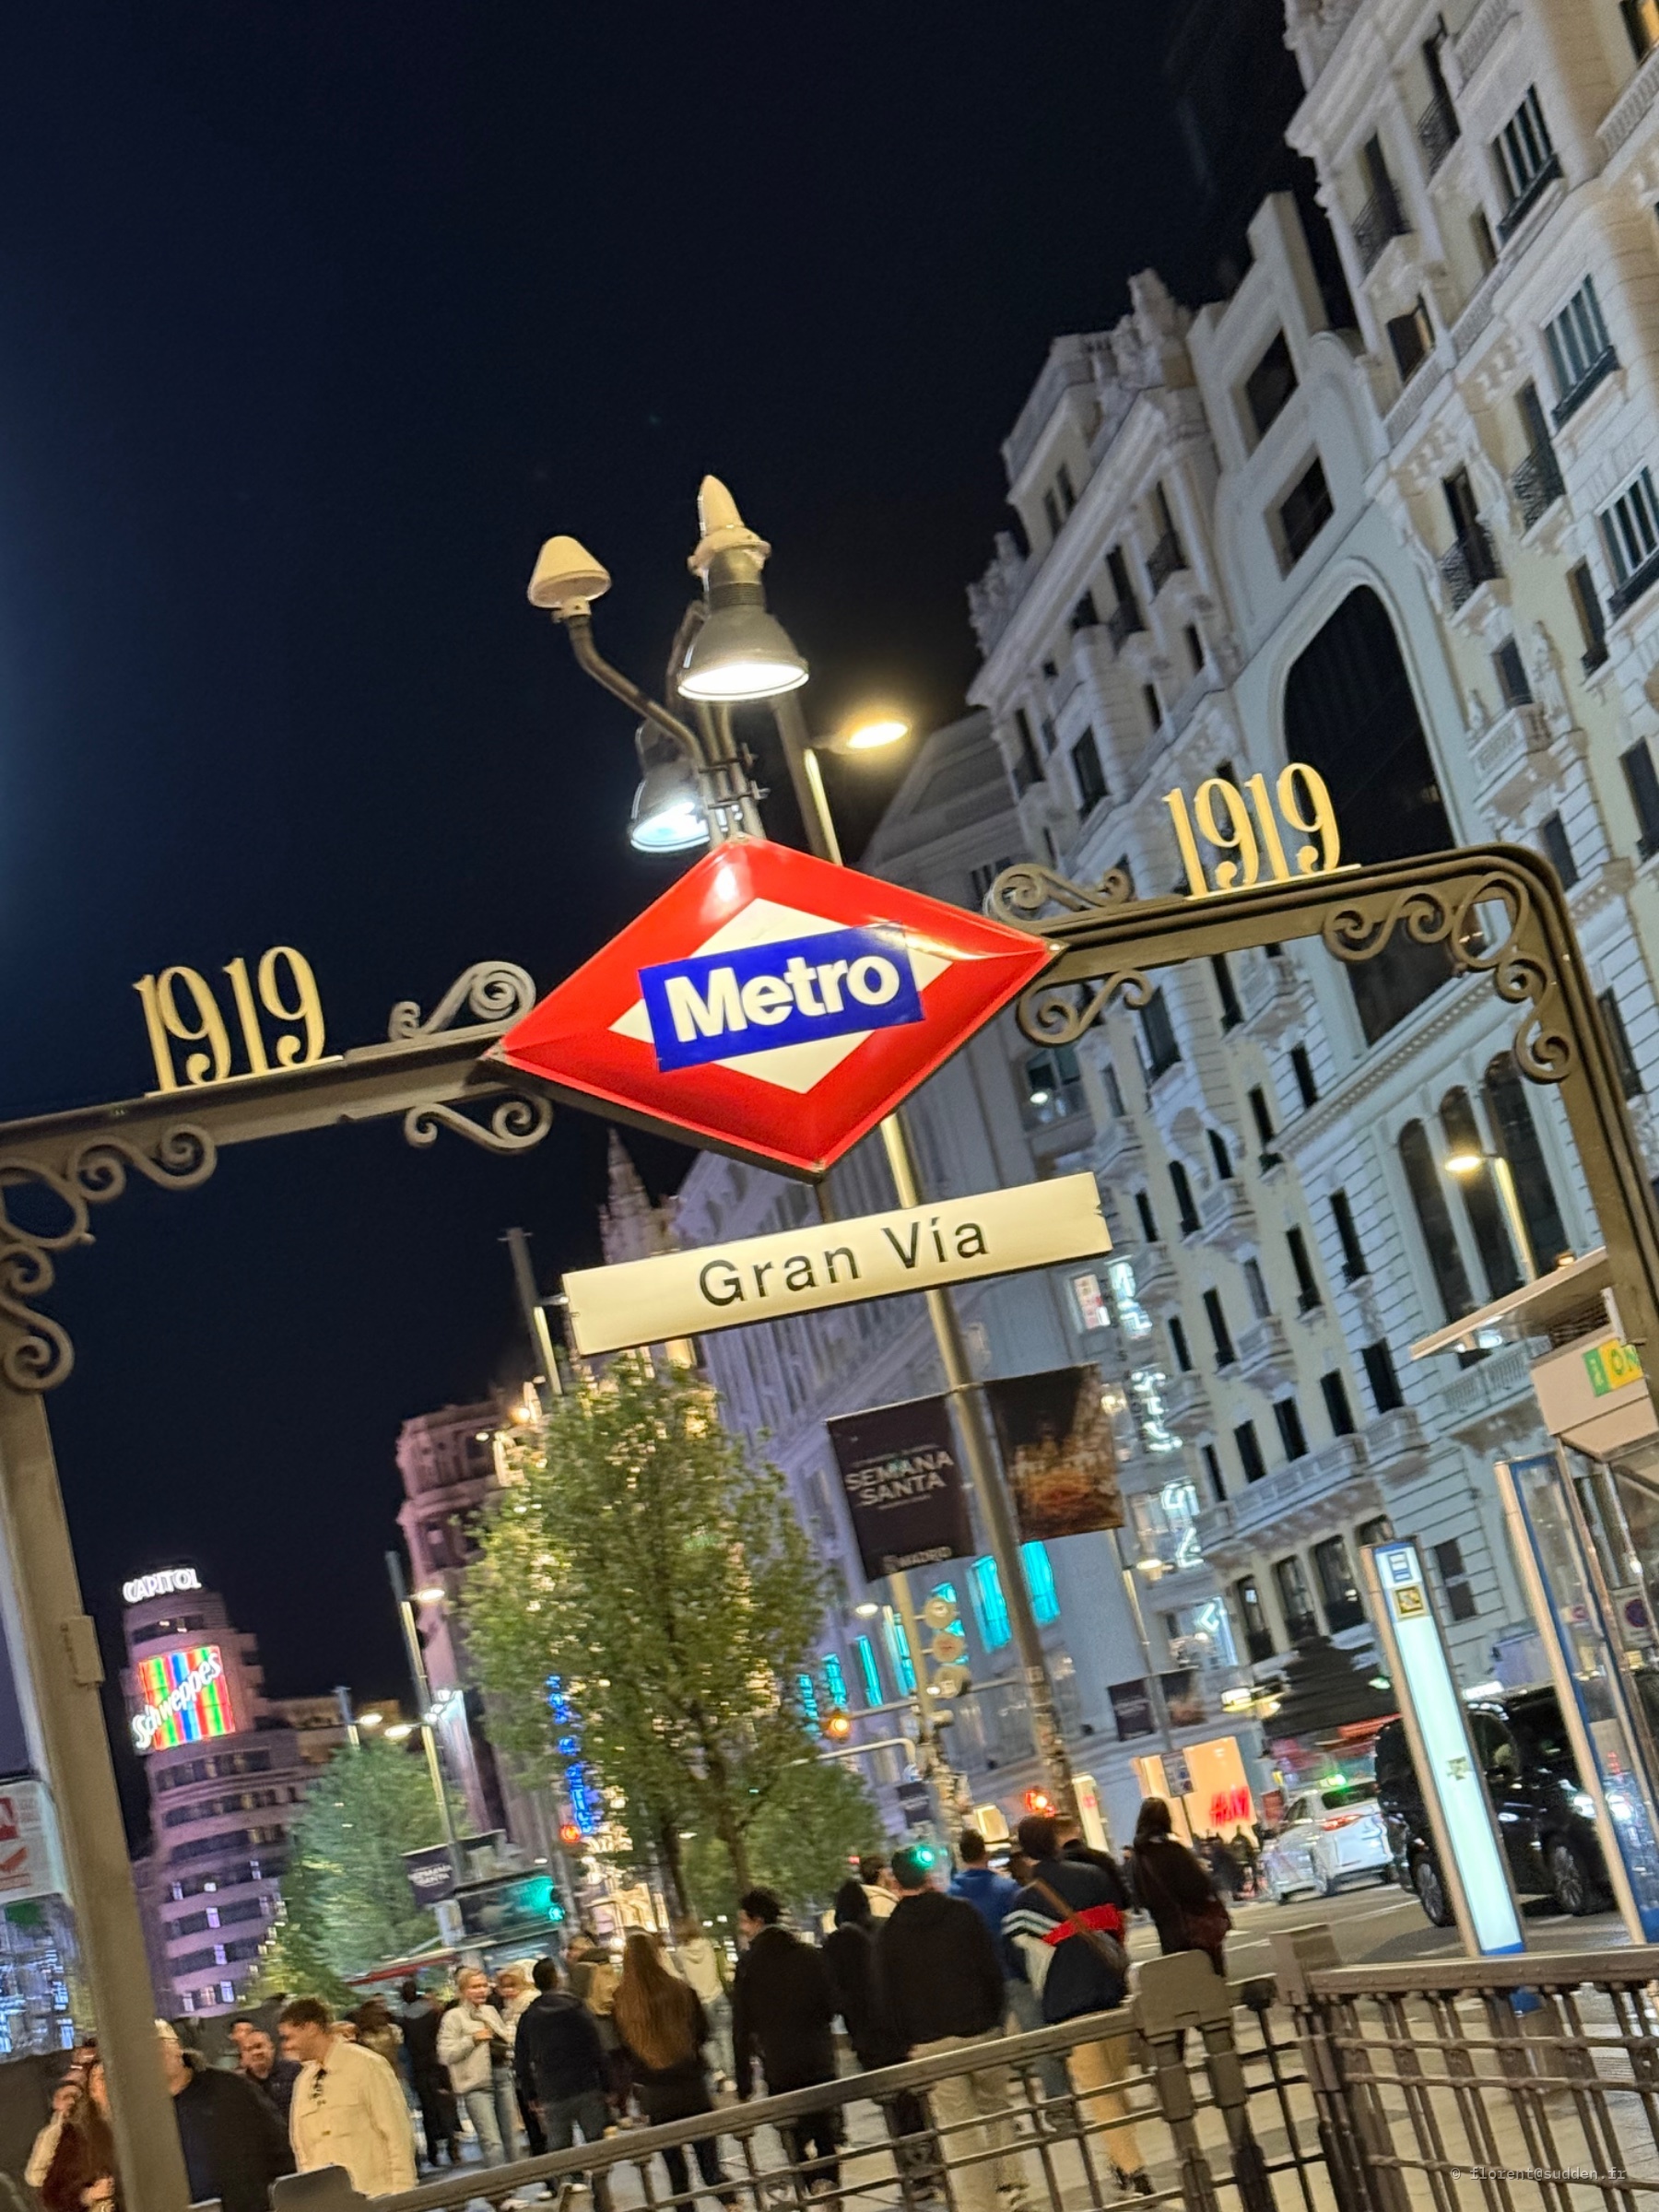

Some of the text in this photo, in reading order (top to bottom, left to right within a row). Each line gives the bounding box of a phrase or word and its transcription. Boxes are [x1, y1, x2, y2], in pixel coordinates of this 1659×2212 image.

[1162, 763, 1340, 898] 1919
[132, 946, 325, 1092] 1919
[665, 956, 900, 1042] Metro
[699, 1217, 990, 1307] Gran Vía
[844, 1451, 955, 1491] SEMANA
[858, 1472, 947, 1506] SANTA
[123, 1568, 202, 1603] CAPITOL
[132, 1653, 221, 1749] Schweppes
